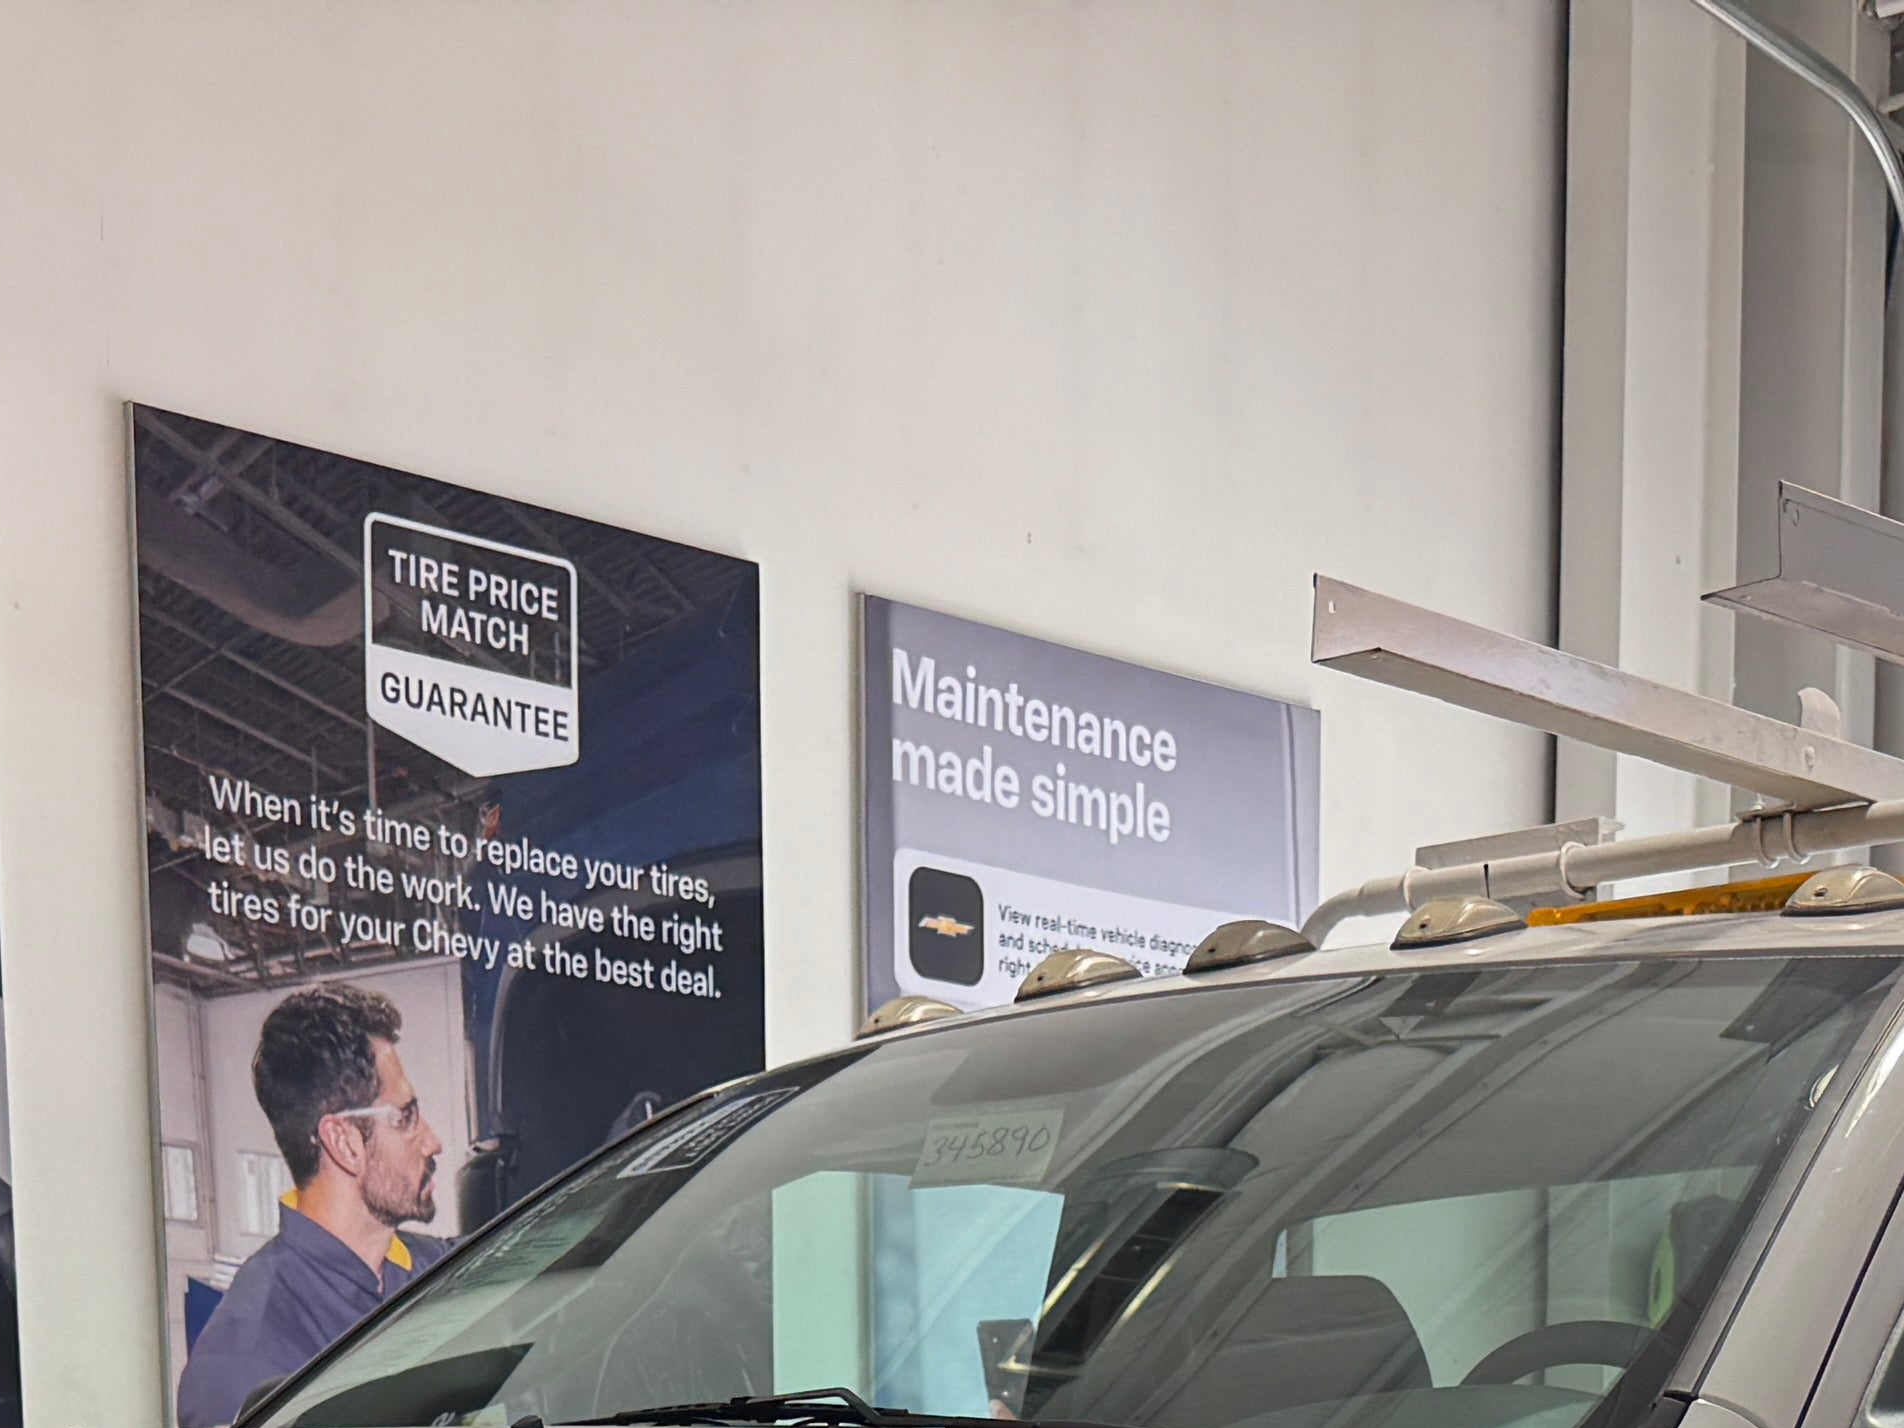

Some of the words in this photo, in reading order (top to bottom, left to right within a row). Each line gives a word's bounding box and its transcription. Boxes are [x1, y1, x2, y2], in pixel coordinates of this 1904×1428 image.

[388, 548, 459, 598] TIRE
[469, 568, 559, 622] PRICE
[420, 600, 529, 655] MATCH
[380, 671, 569, 742] GUARANTEE
[892, 648, 1177, 772] Maintenance
[892, 738, 1019, 809] made
[1031, 763, 1171, 845] simple
[209, 775, 301, 826] When
[310, 795, 356, 836] it's
[363, 808, 430, 850] time
[438, 824, 468, 858] to
[476, 837, 578, 880] replace
[584, 858, 645, 891] your
[650, 864, 715, 909] tires,
[204, 825, 245, 866] let
[254, 844, 289, 874] us
[299, 845, 336, 883] do
[345, 855, 394, 894] the
[401, 873, 480, 911] work.
[488, 882, 534, 920] We
[541, 890, 604, 932] have
[611, 905, 655, 941] the
[662, 912, 723, 954] right
[208, 881, 279, 923] tires
[287, 895, 332, 932] for
[339, 911, 405, 944] your
[413, 919, 500, 970] Chevy
[508, 940, 536, 970] at
[543, 942, 589, 978] the
[595, 948, 654, 989] best
[660, 960, 722, 999] deal.
[998, 904, 1031, 927] View
[1035, 912, 1096, 940] real-time
[1100, 926, 1145, 950] vehicle
[998, 932, 1024, 952] and
[998, 957, 1031, 980] right
